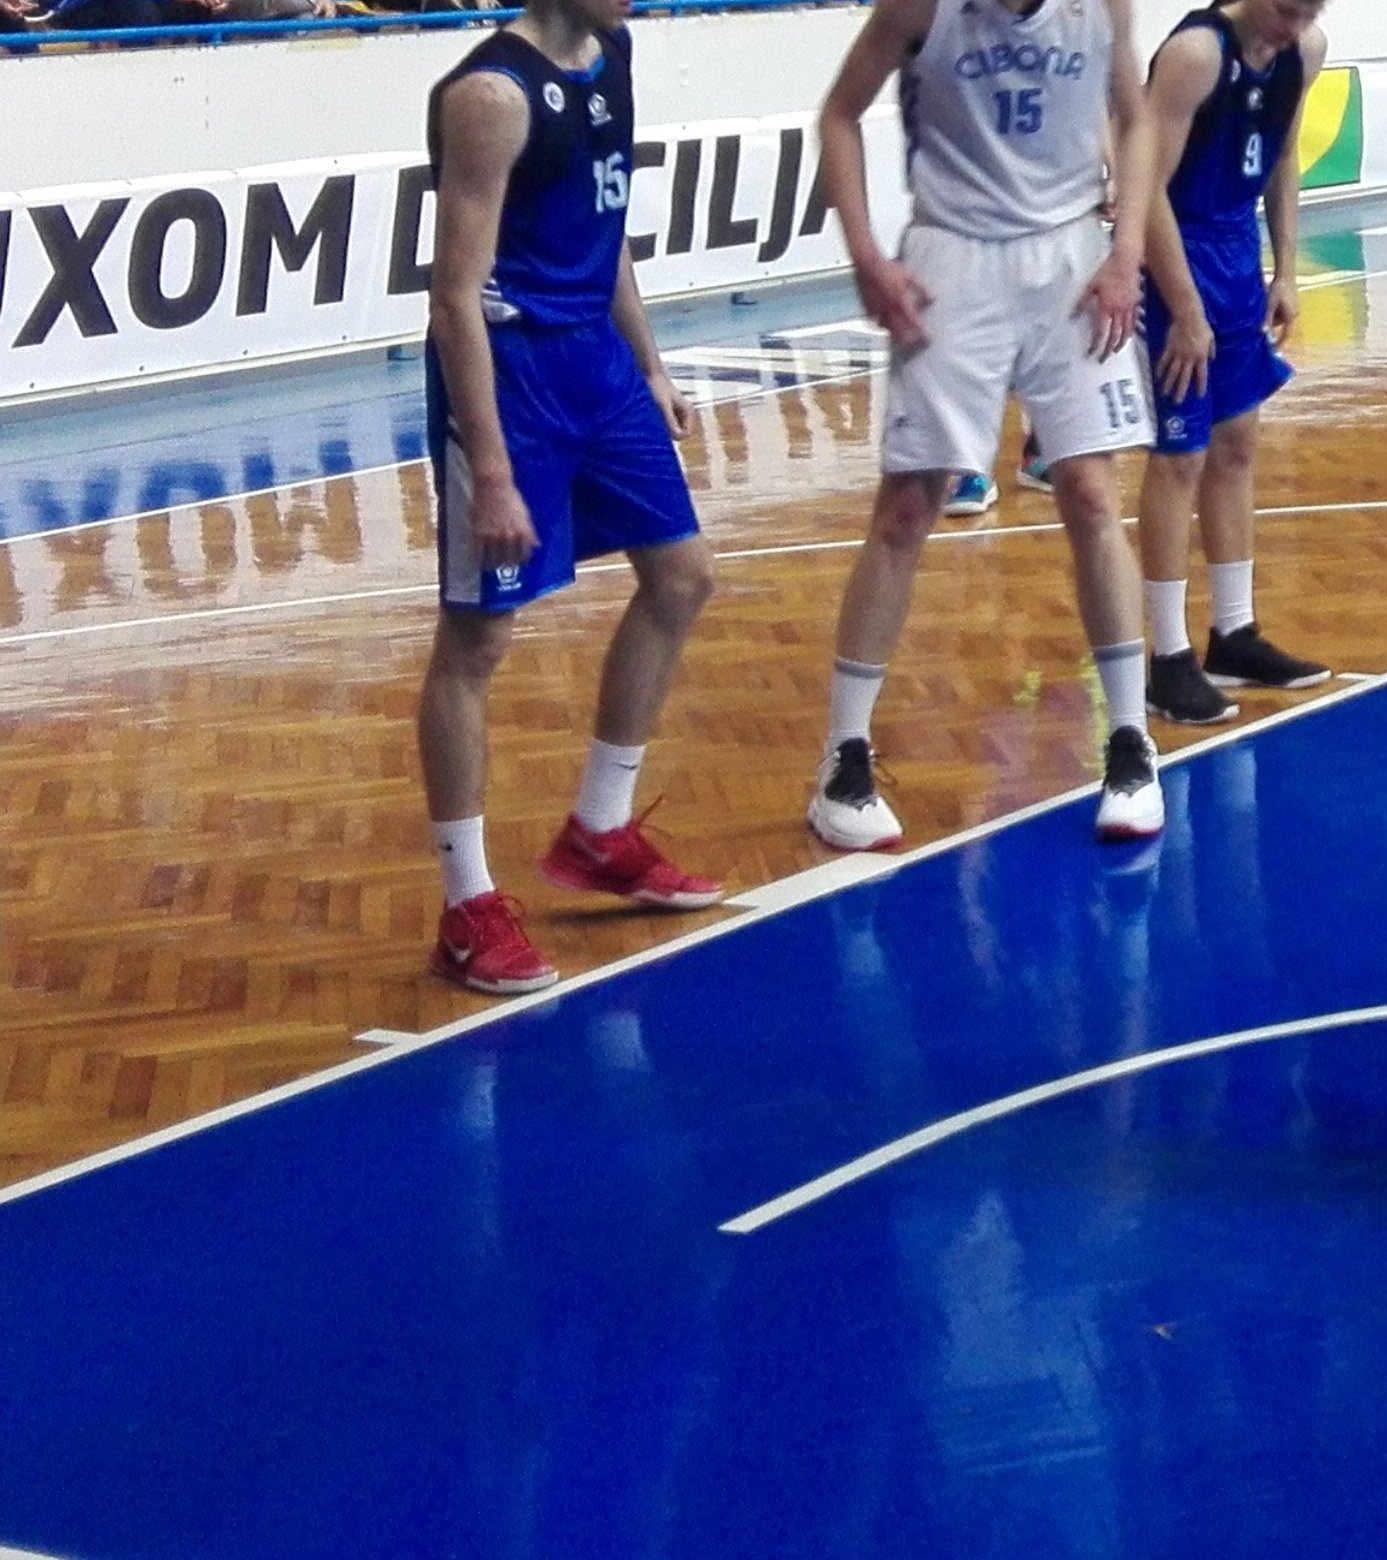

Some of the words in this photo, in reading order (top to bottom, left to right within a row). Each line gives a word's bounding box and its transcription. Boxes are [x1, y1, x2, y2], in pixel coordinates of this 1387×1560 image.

[953, 43, 1086, 80] CIBONA
[995, 87, 1043, 135] 15
[591, 151, 630, 214] 15
[1241, 137, 1264, 178] 9
[0, 173, 357, 349] XOM
[1098, 377, 1138, 430] 15
